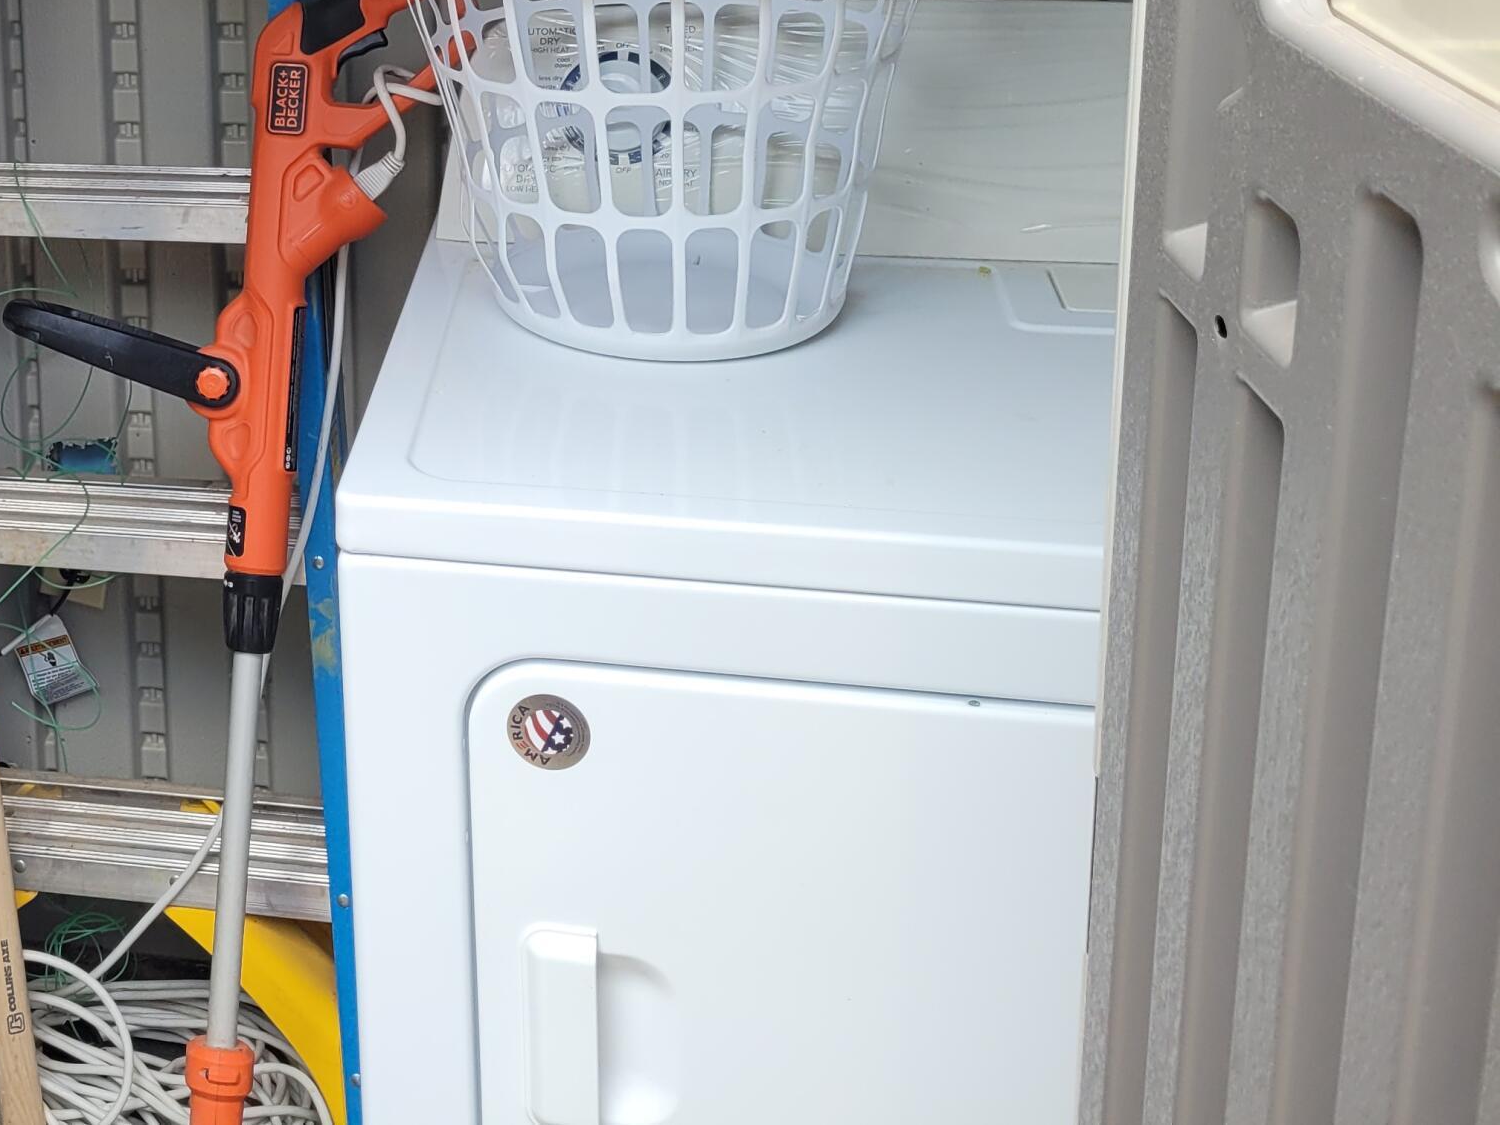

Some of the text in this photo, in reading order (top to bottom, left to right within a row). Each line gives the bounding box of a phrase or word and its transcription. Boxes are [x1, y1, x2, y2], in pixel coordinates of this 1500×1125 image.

[528, 27, 576, 35] UTOMATI
[540, 37, 561, 45] DRY
[665, 25, 696, 34] TED
[274, 70, 288, 127] BLACK+
[287, 70, 302, 128] DECKER
[510, 705, 551, 765] AMERICA
[0, 939, 11, 963] AXE
[4, 965, 17, 1012] COLLINS
